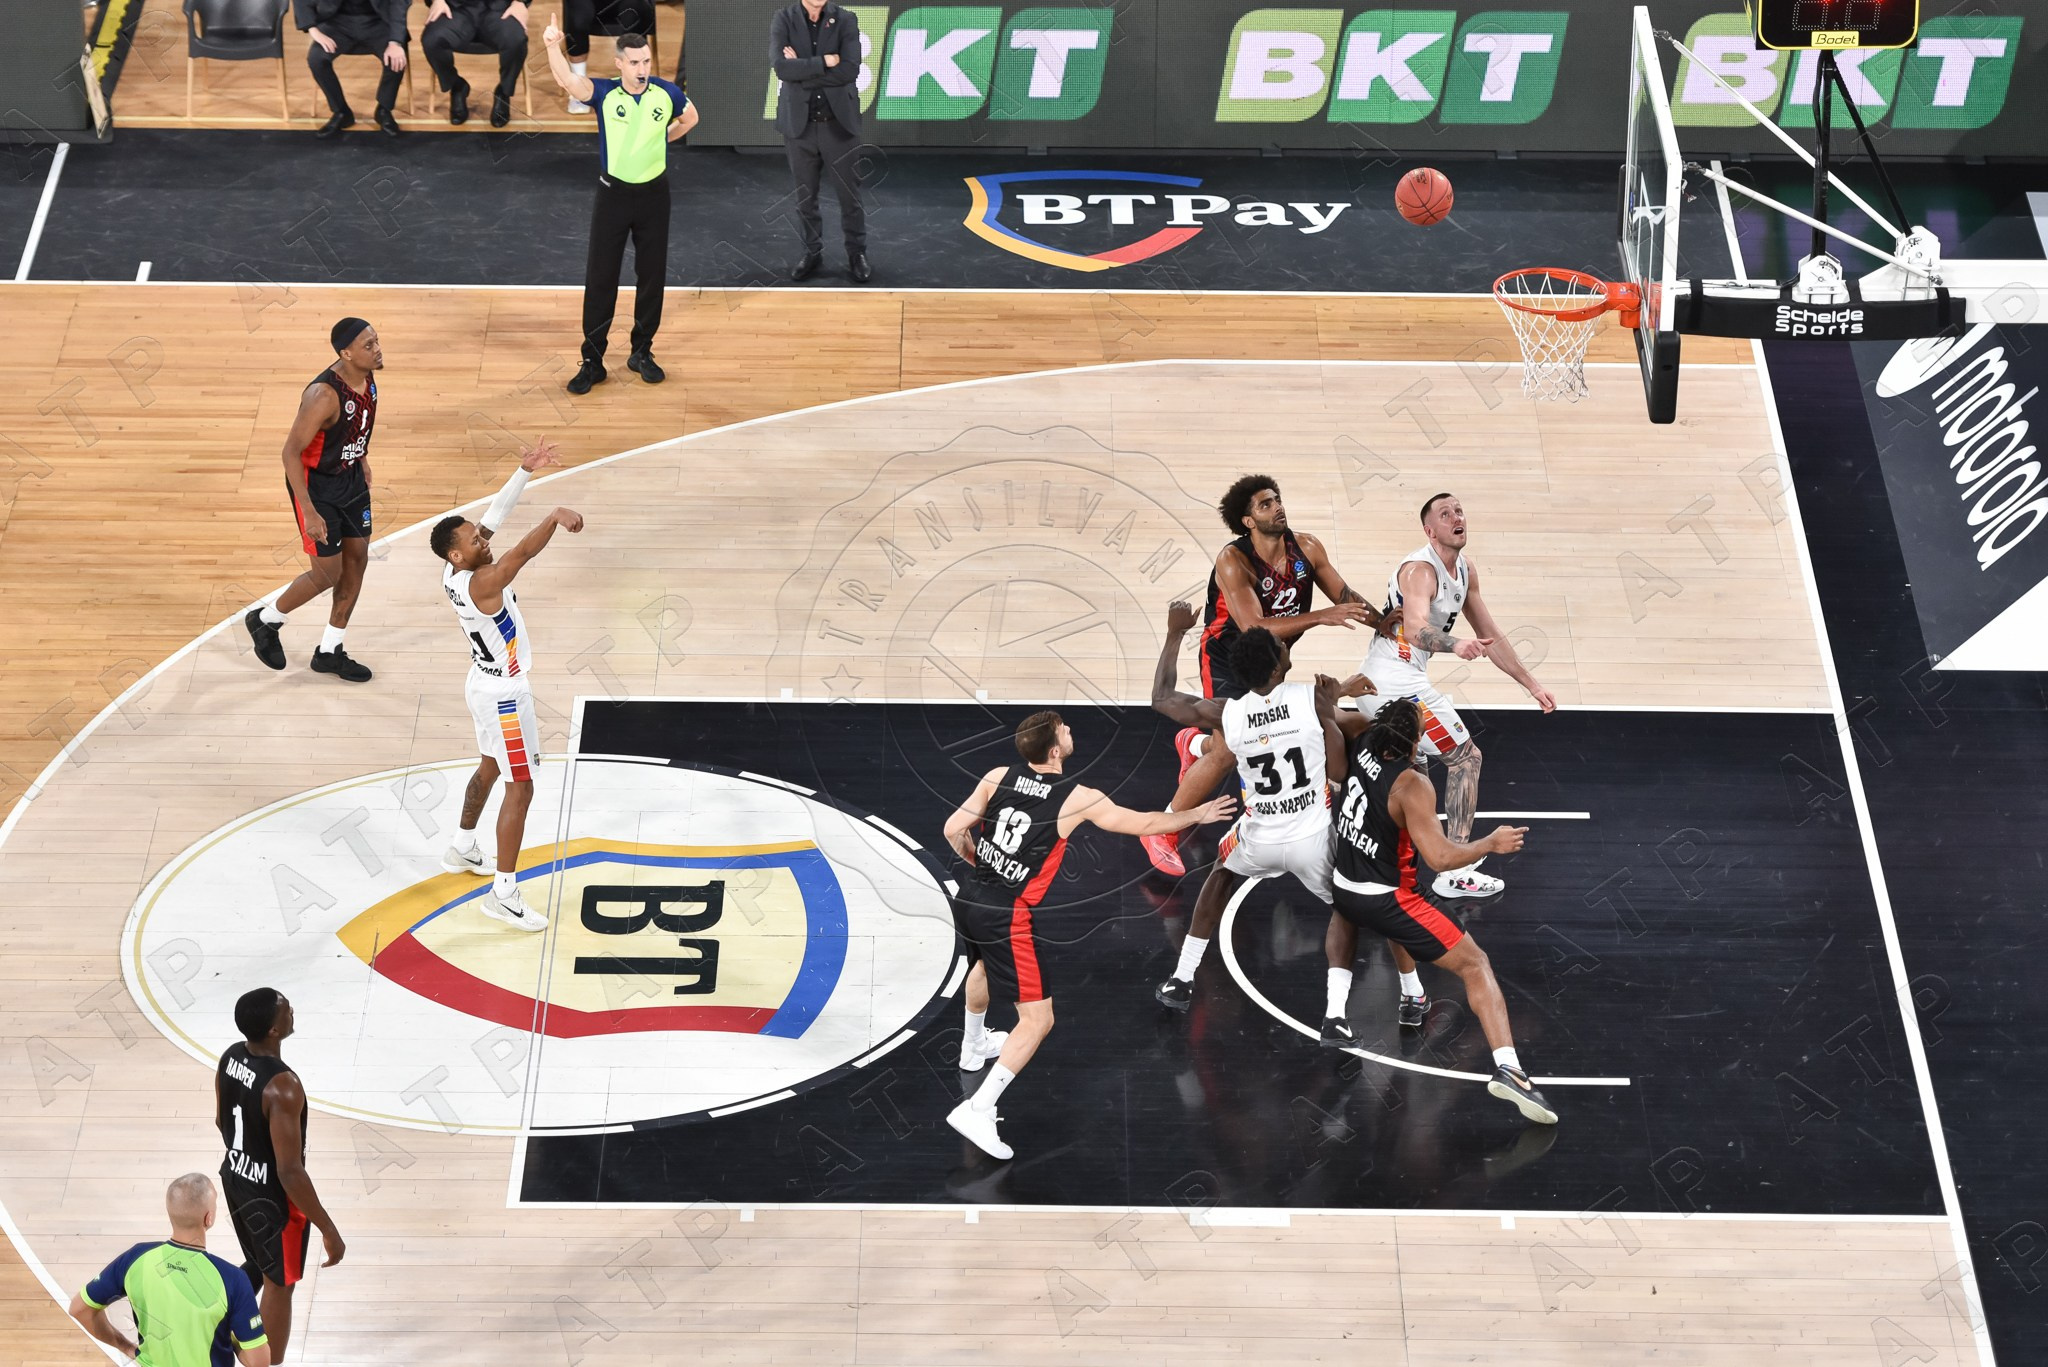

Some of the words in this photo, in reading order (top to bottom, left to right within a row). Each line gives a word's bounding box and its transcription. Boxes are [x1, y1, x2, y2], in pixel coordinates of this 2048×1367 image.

[1814, 33, 1857, 45] Bodet
[859, 28, 1100, 98] KT
[1228, 31, 1553, 101] BKT
[1680, 36, 2008, 106] BKT
[1775, 318, 1864, 337] Sports
[1776, 305, 1864, 323] Schelde
[1931, 346, 2048, 572] motorola
[1271, 587, 1297, 610] 22
[1442, 612, 1458, 633] 5
[1247, 704, 1290, 729] MENSAH
[1013, 775, 1052, 800] HUBER
[1246, 746, 1311, 796] 31
[992, 806, 1032, 855] 13
[976, 837, 1030, 882] ERUSALEM
[574, 880, 725, 995] BT
[225, 1056, 257, 1090] HARPER
[232, 1104, 244, 1151] 1
[228, 1150, 268, 1185] SALEM
